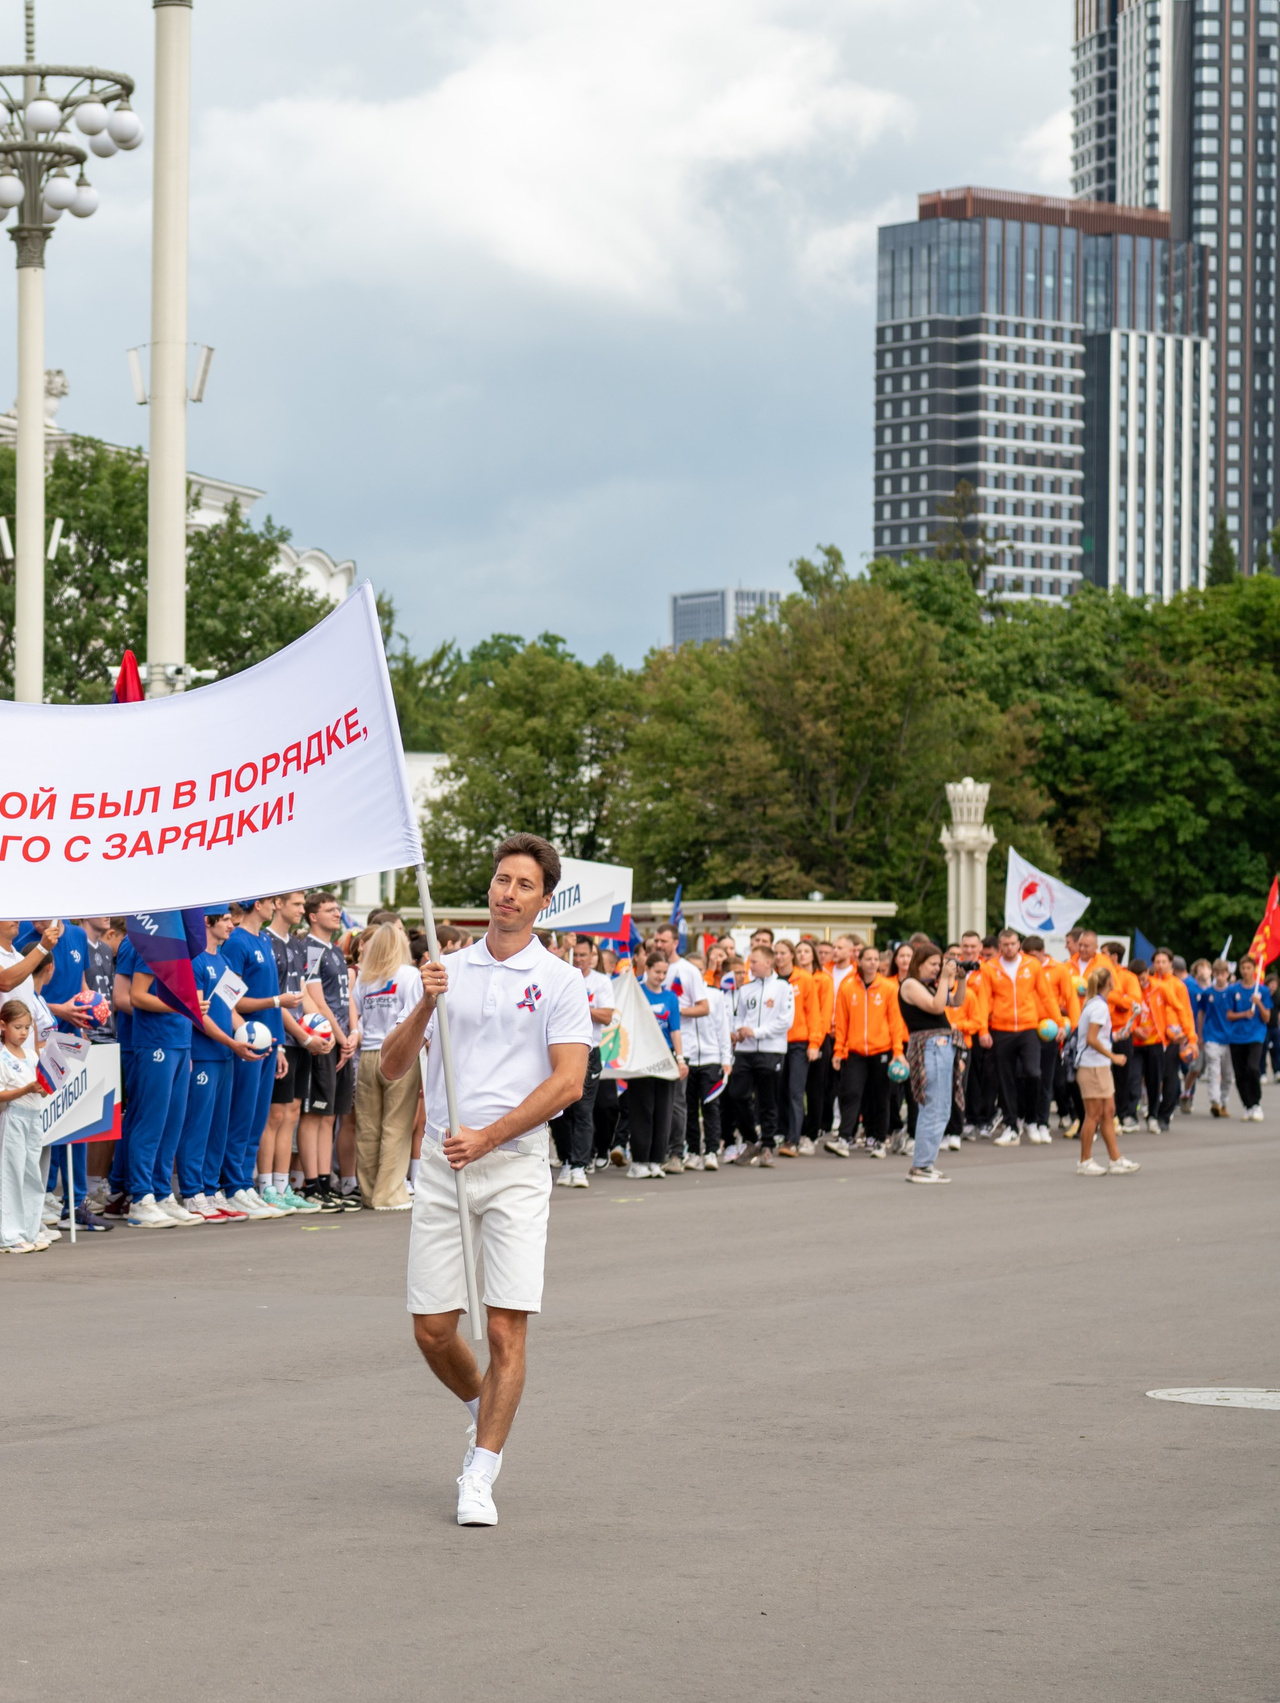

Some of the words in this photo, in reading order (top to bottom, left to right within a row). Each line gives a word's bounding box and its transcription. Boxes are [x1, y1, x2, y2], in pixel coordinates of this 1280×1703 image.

[70, 786, 160, 820] БЫЛ
[173, 780, 196, 809] В
[209, 708, 369, 802] ПОРЯДКЕ,
[64, 836, 90, 862] С
[103, 792, 296, 861] ЗАРЯДКИ!
[40, 1067, 87, 1133] ОЛЕЙБОЛ
